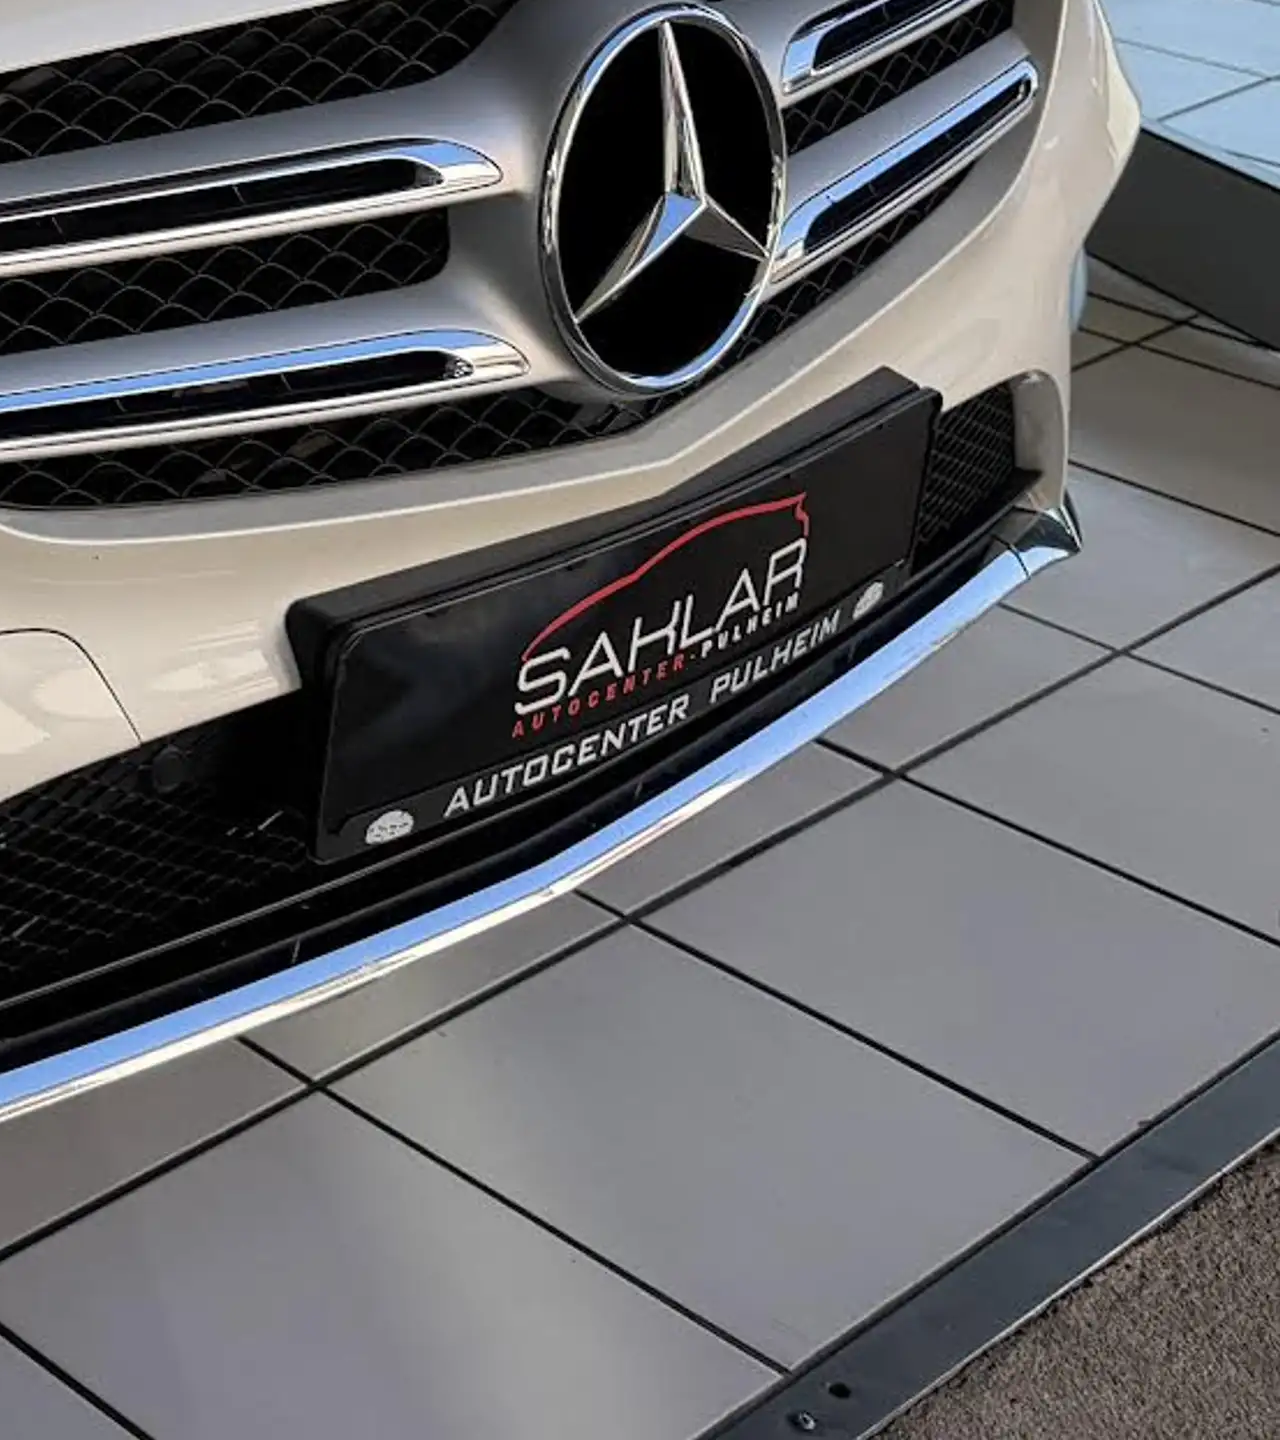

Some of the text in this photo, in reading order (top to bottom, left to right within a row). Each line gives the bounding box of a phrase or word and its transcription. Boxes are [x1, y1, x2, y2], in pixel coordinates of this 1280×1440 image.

[442, 608, 841, 818] AUTOCENTER PULHEIM
[514, 537, 808, 715] SAHLAR
